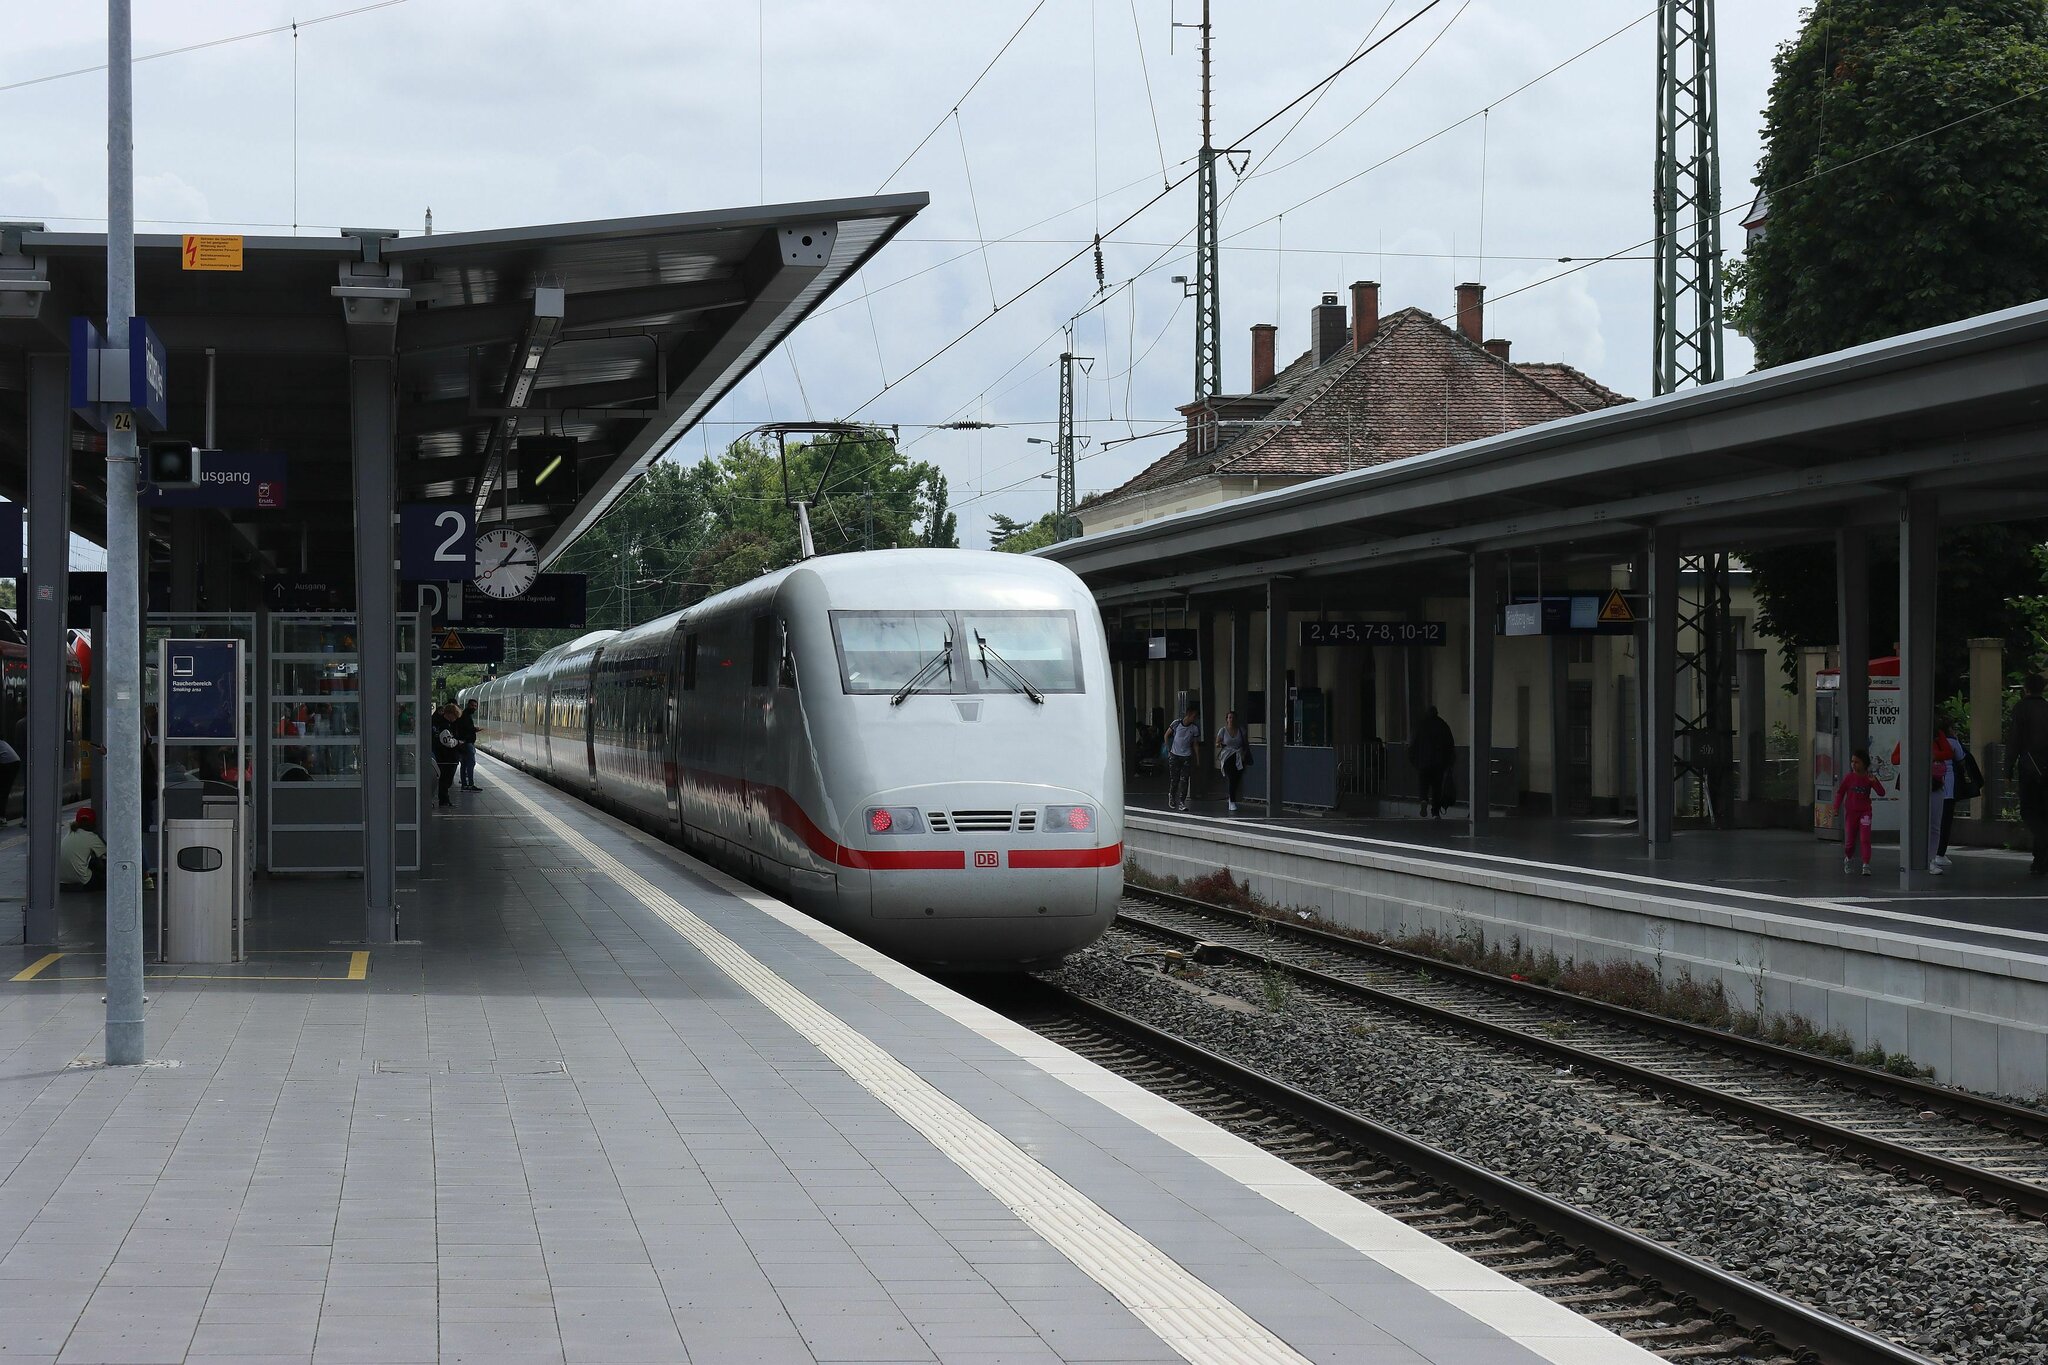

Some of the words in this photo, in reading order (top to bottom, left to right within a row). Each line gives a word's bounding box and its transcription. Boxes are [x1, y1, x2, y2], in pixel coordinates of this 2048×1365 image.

[115, 414, 131, 430] 24
[199, 471, 251, 485] usgang
[433, 510, 467, 562] 2
[294, 583, 327, 592] Ausgang
[418, 584, 442, 617] D
[1311, 624, 1325, 642] 2,
[1329, 624, 1360, 642] 4-5,
[1364, 624, 1394, 642] 7-8,
[1399, 624, 1439, 640] 10-12
[1879, 706, 1900, 715] NOCH
[1876, 716, 1896, 725] VOR?
[977, 853, 997, 865] DB
